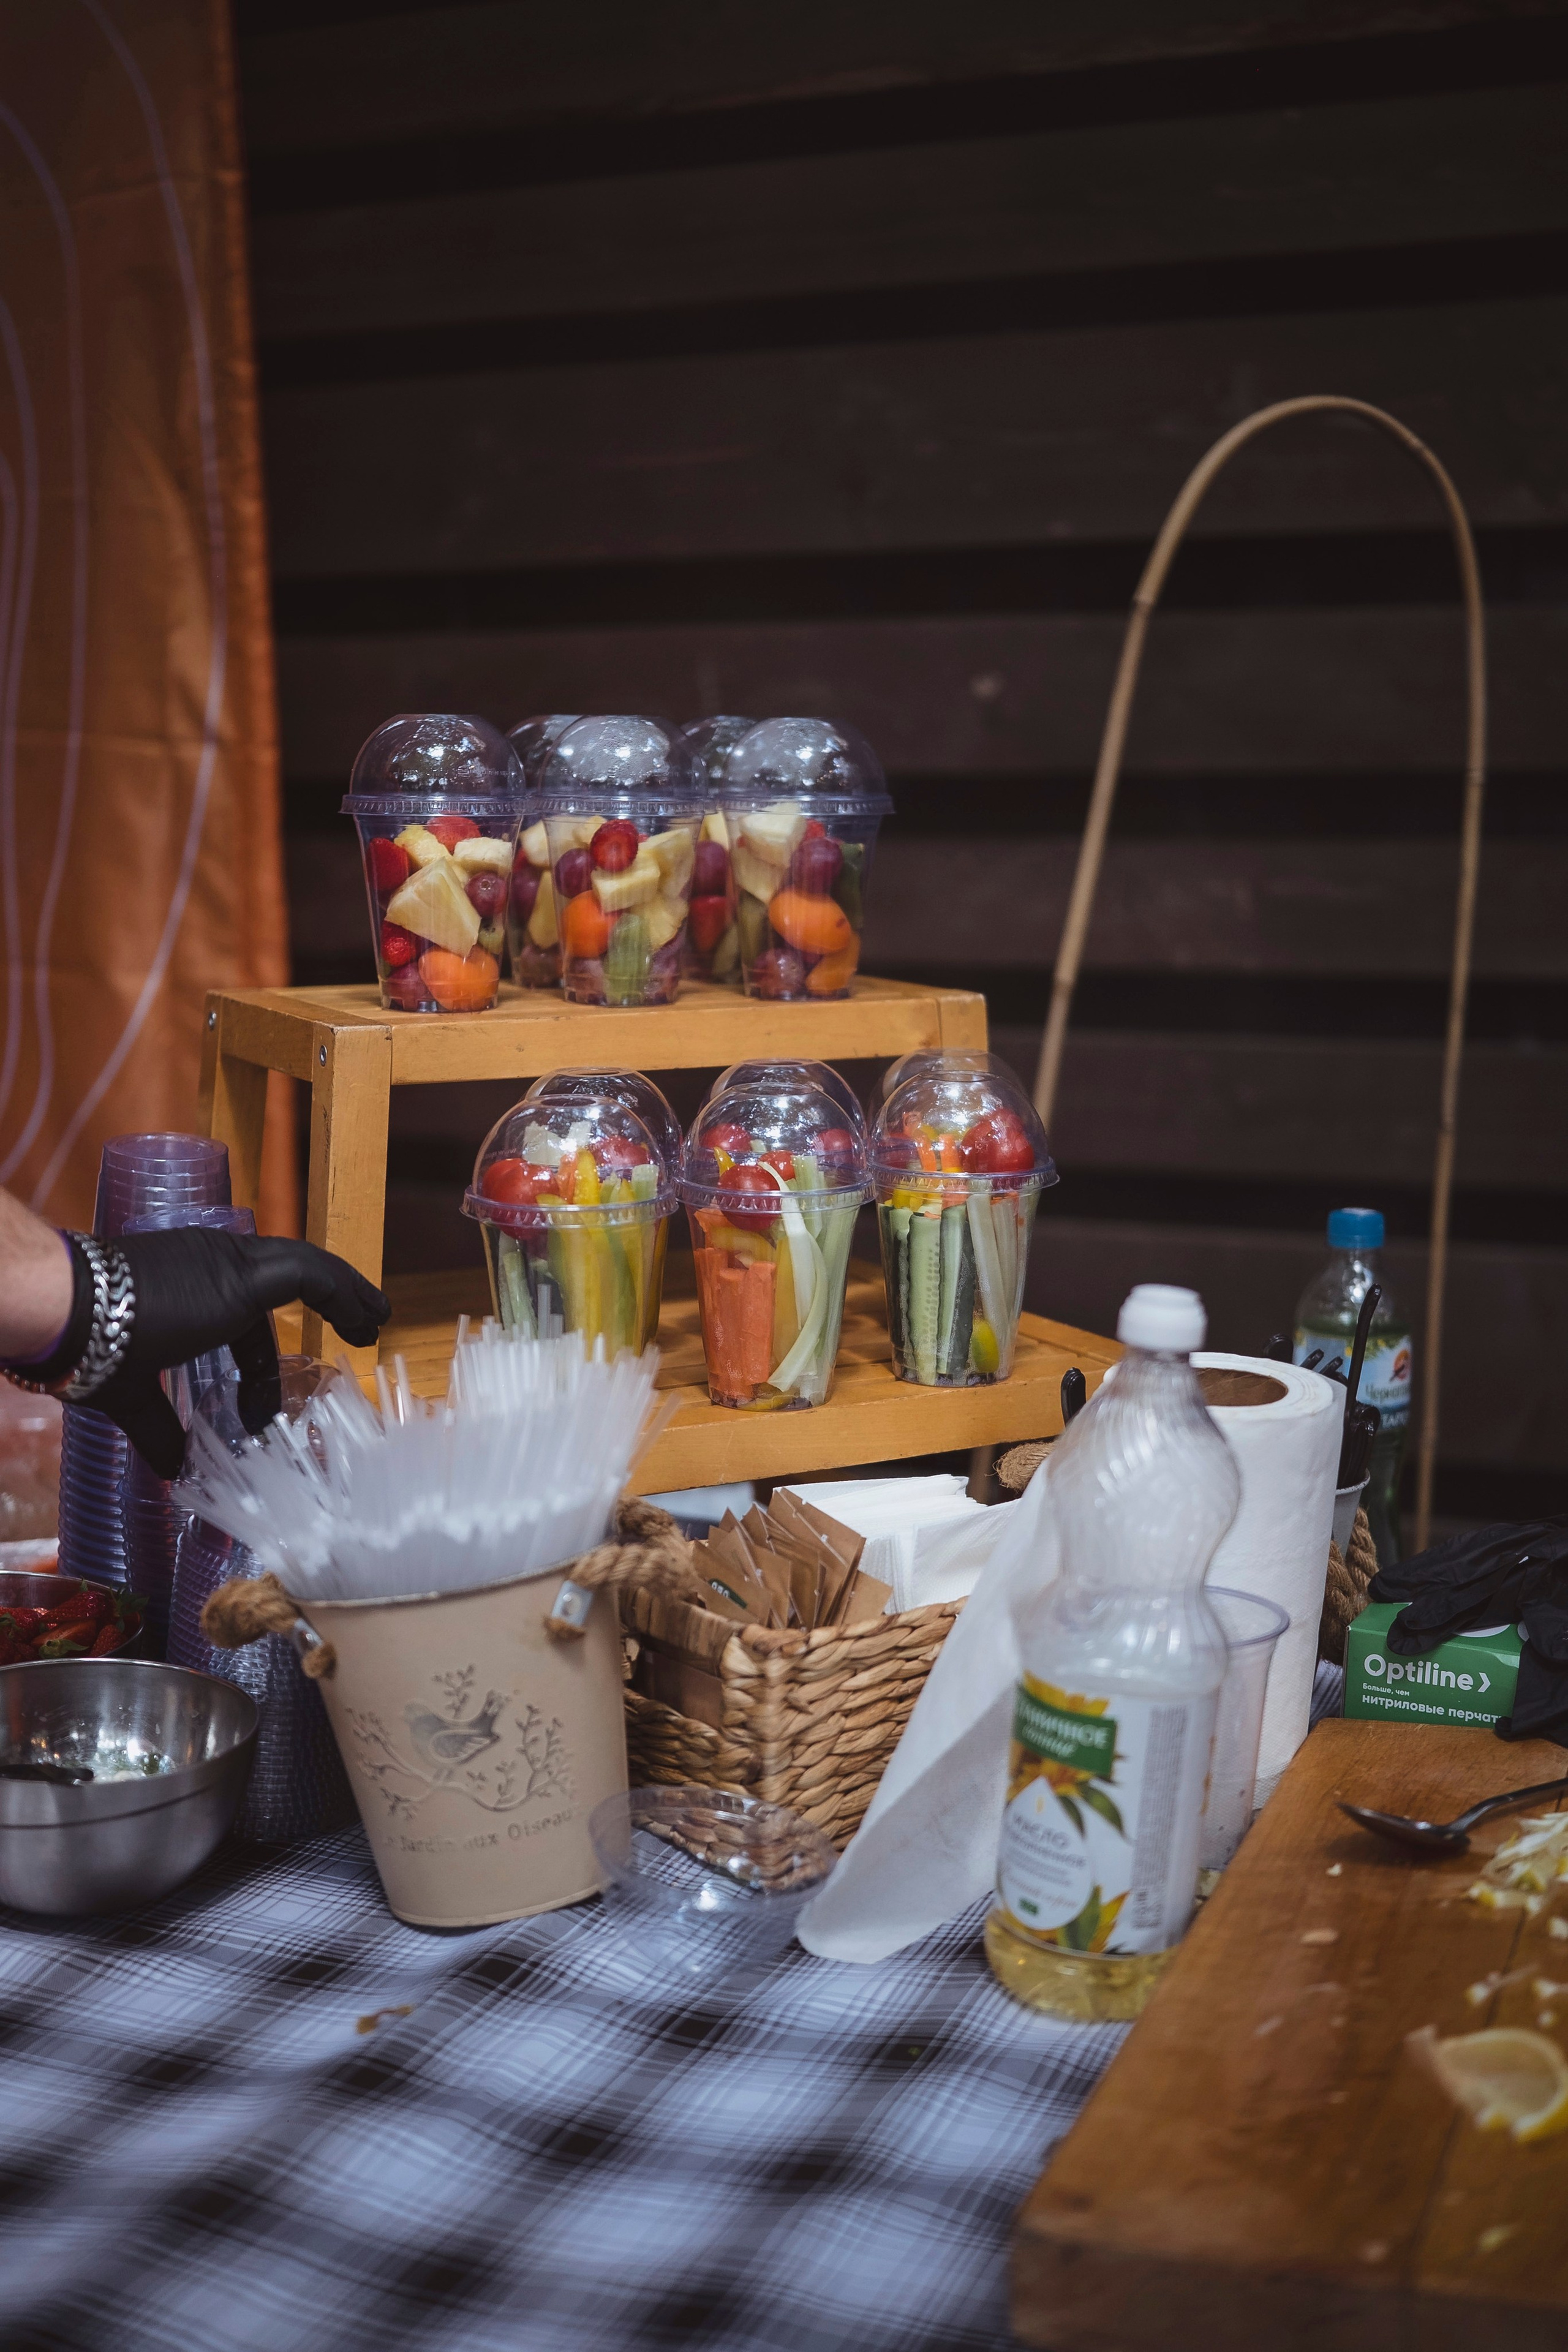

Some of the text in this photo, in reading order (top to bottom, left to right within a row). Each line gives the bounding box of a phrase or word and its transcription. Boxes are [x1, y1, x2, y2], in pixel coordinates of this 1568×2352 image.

[1364, 1654, 1474, 1691] Optiline
[1362, 1683, 1410, 1697] Больше, чем
[1362, 1694, 1502, 1724] нитриловые перчат
